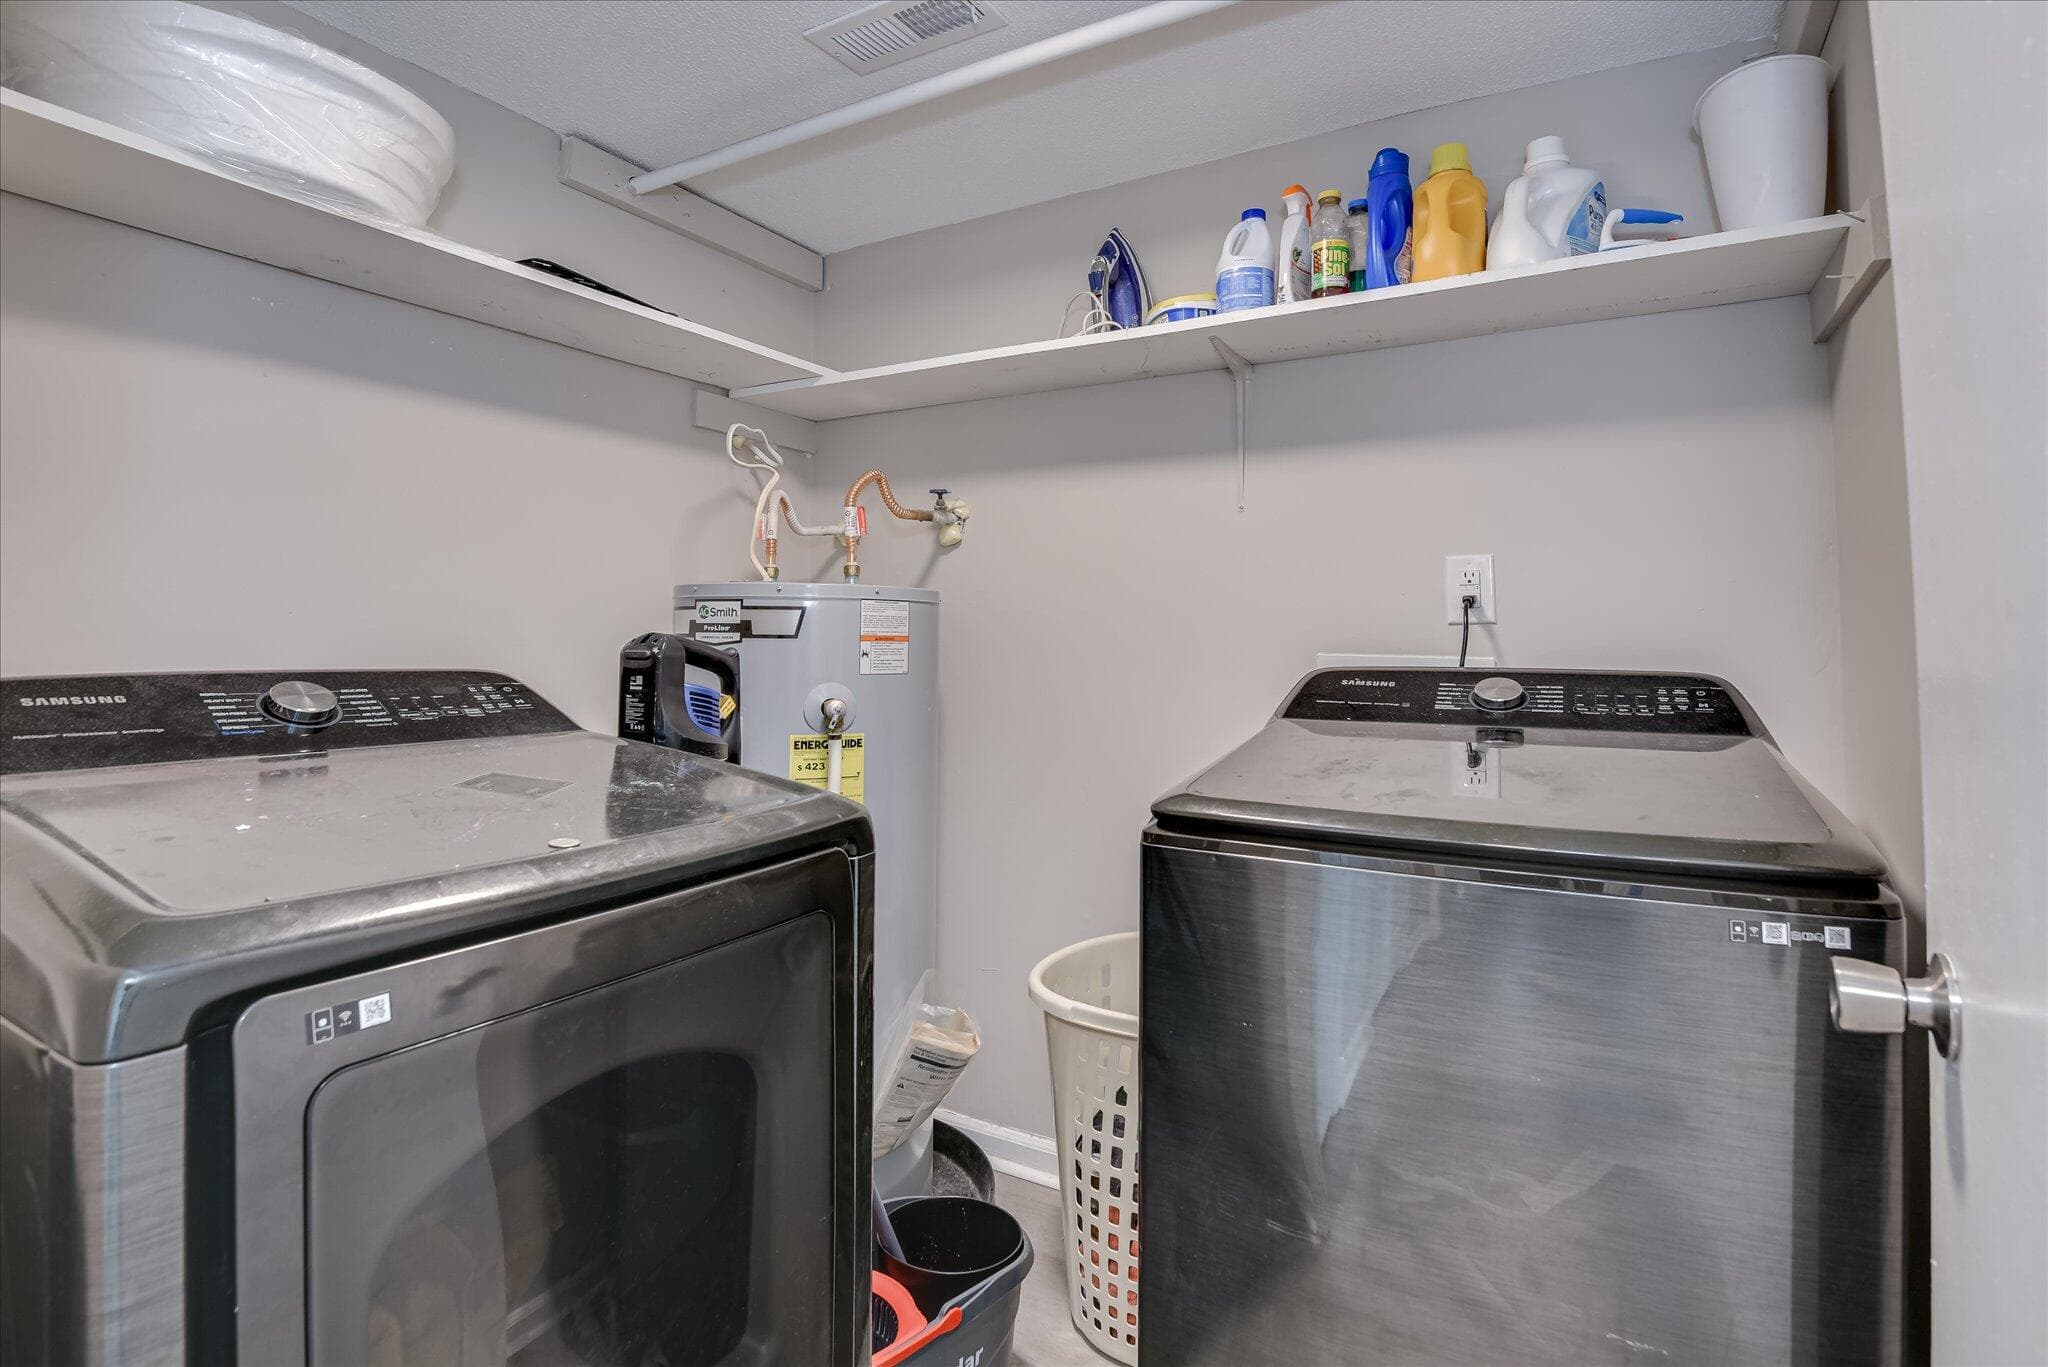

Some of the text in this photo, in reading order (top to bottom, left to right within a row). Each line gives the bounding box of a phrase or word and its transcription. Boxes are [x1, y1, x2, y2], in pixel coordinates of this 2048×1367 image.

[710, 607, 738, 618] Smith
[20, 695, 127, 706] SAMSUNG
[793, 738, 863, 750] ENERG UIDE
[804, 762, 826, 771] 423
